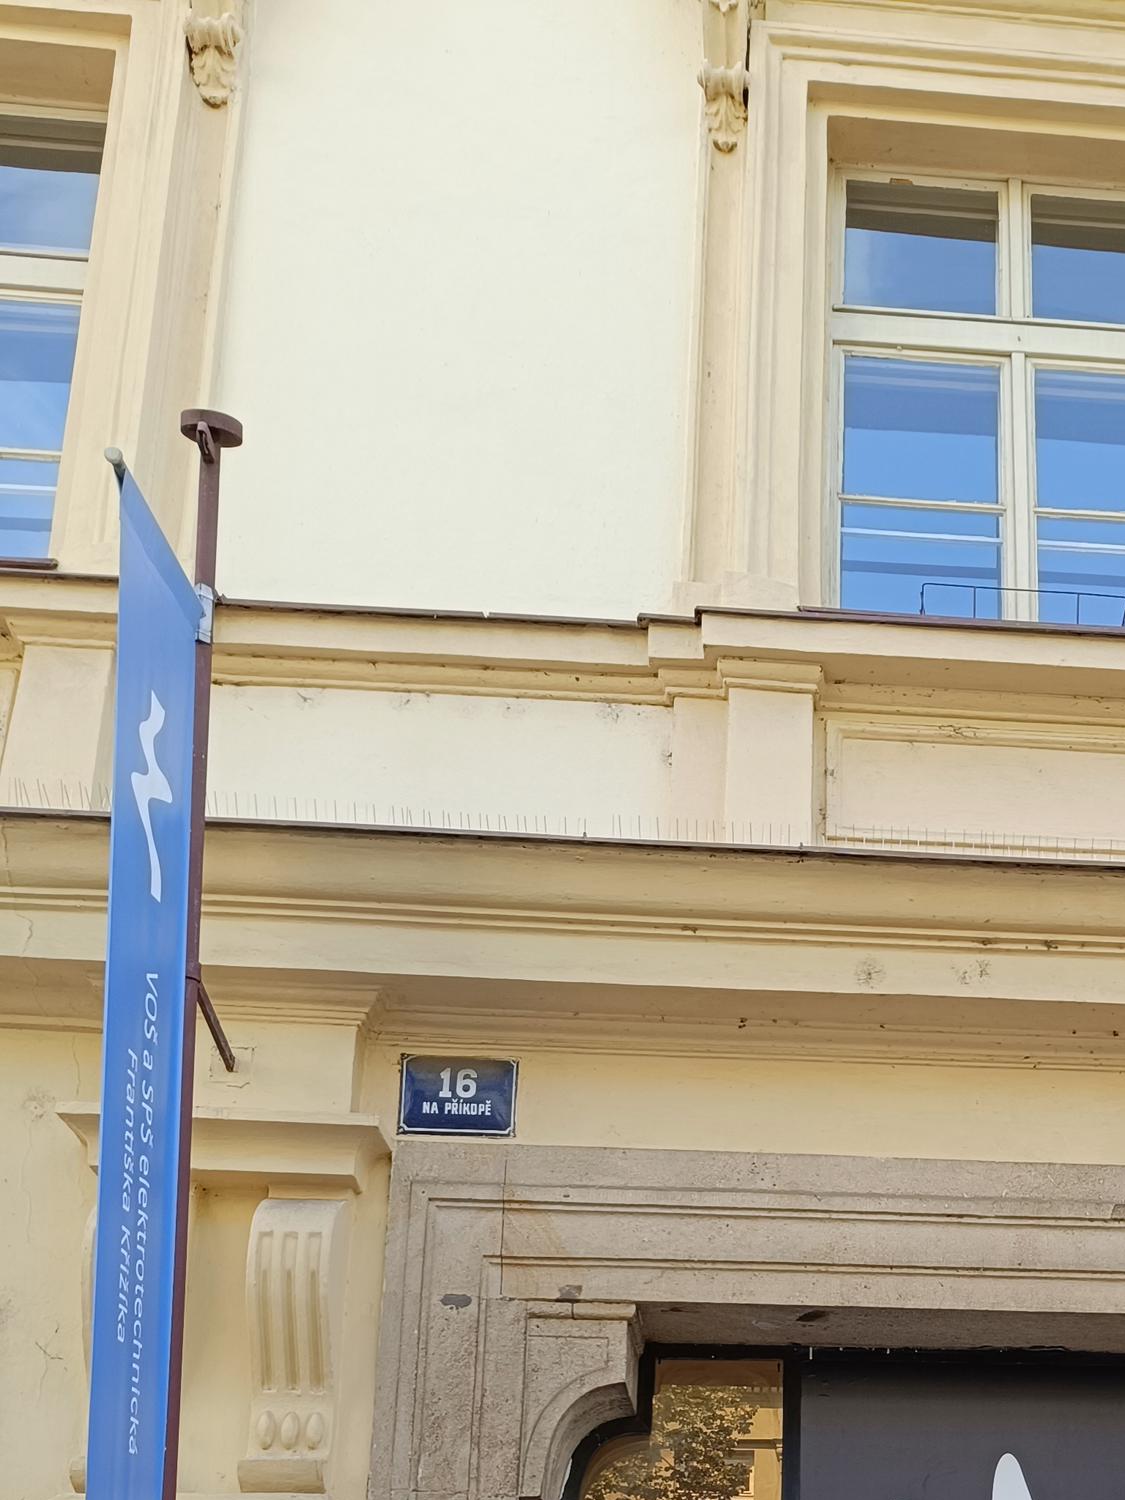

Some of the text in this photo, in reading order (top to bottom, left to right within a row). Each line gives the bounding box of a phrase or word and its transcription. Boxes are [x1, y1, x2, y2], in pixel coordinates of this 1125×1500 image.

[122, 1048, 138, 1213] Františka
[422, 1098, 492, 1116] NA PŘÍKOPĚ
[439, 1067, 478, 1098] 16
[128, 972, 159, 1456] VOŠ a SPŠ elektrotechnická
